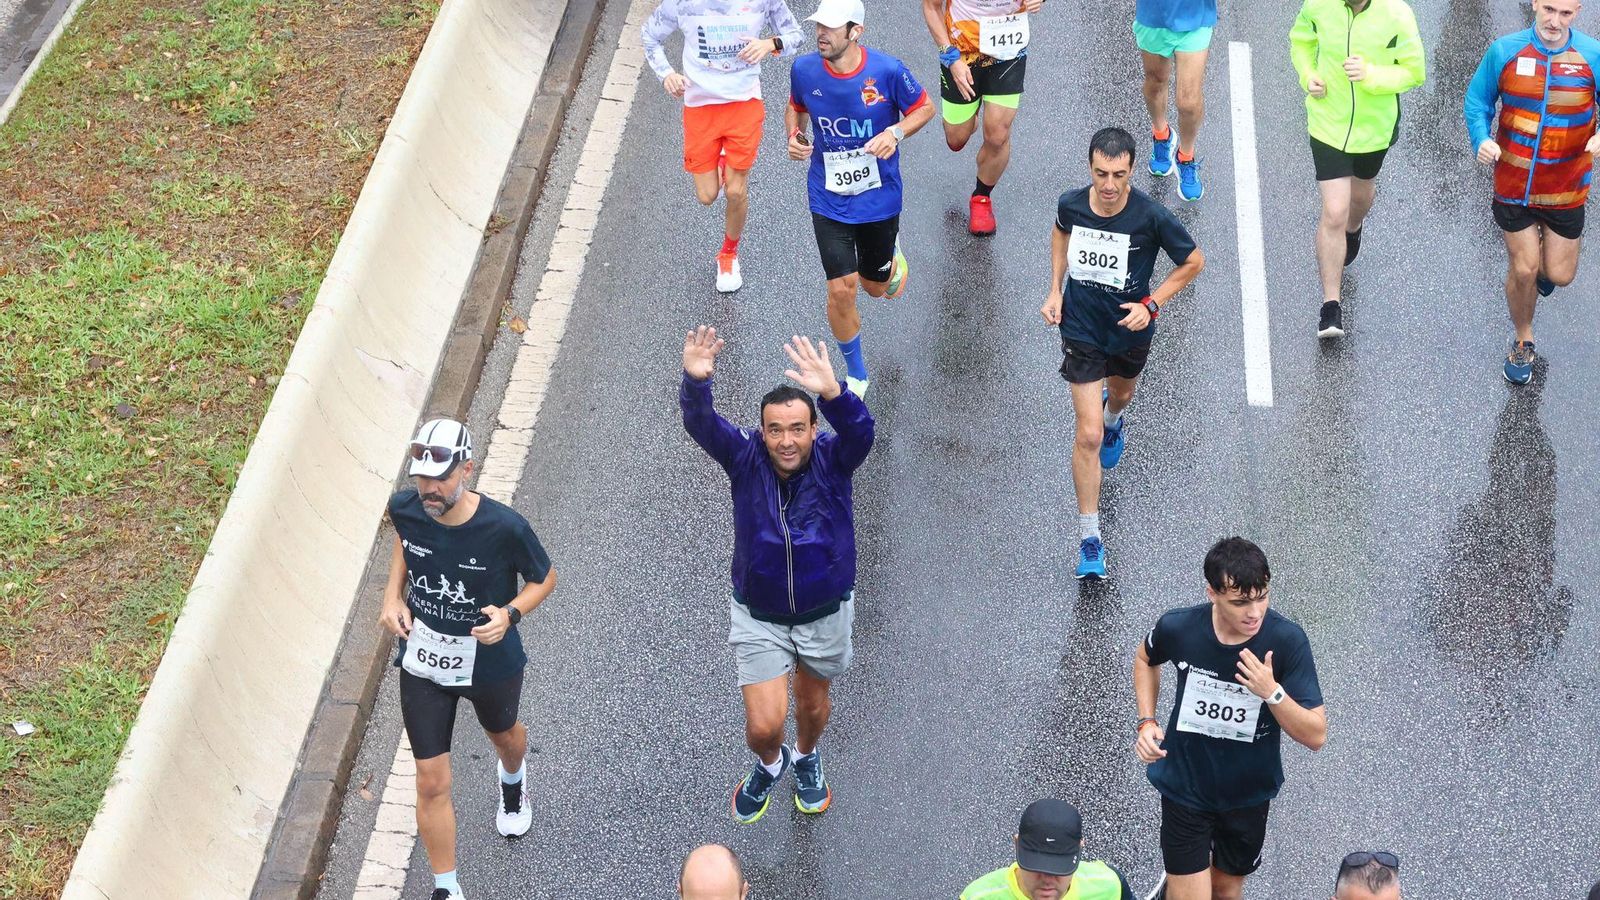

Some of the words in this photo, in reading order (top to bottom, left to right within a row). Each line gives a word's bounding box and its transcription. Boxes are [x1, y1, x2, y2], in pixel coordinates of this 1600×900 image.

[990, 32, 1023, 47] 1412
[818, 116, 873, 138] RCM
[834, 166, 871, 186] 3969
[1078, 250, 1118, 269] 3802
[417, 648, 464, 670] 6562
[1194, 700, 1247, 723] 3803
